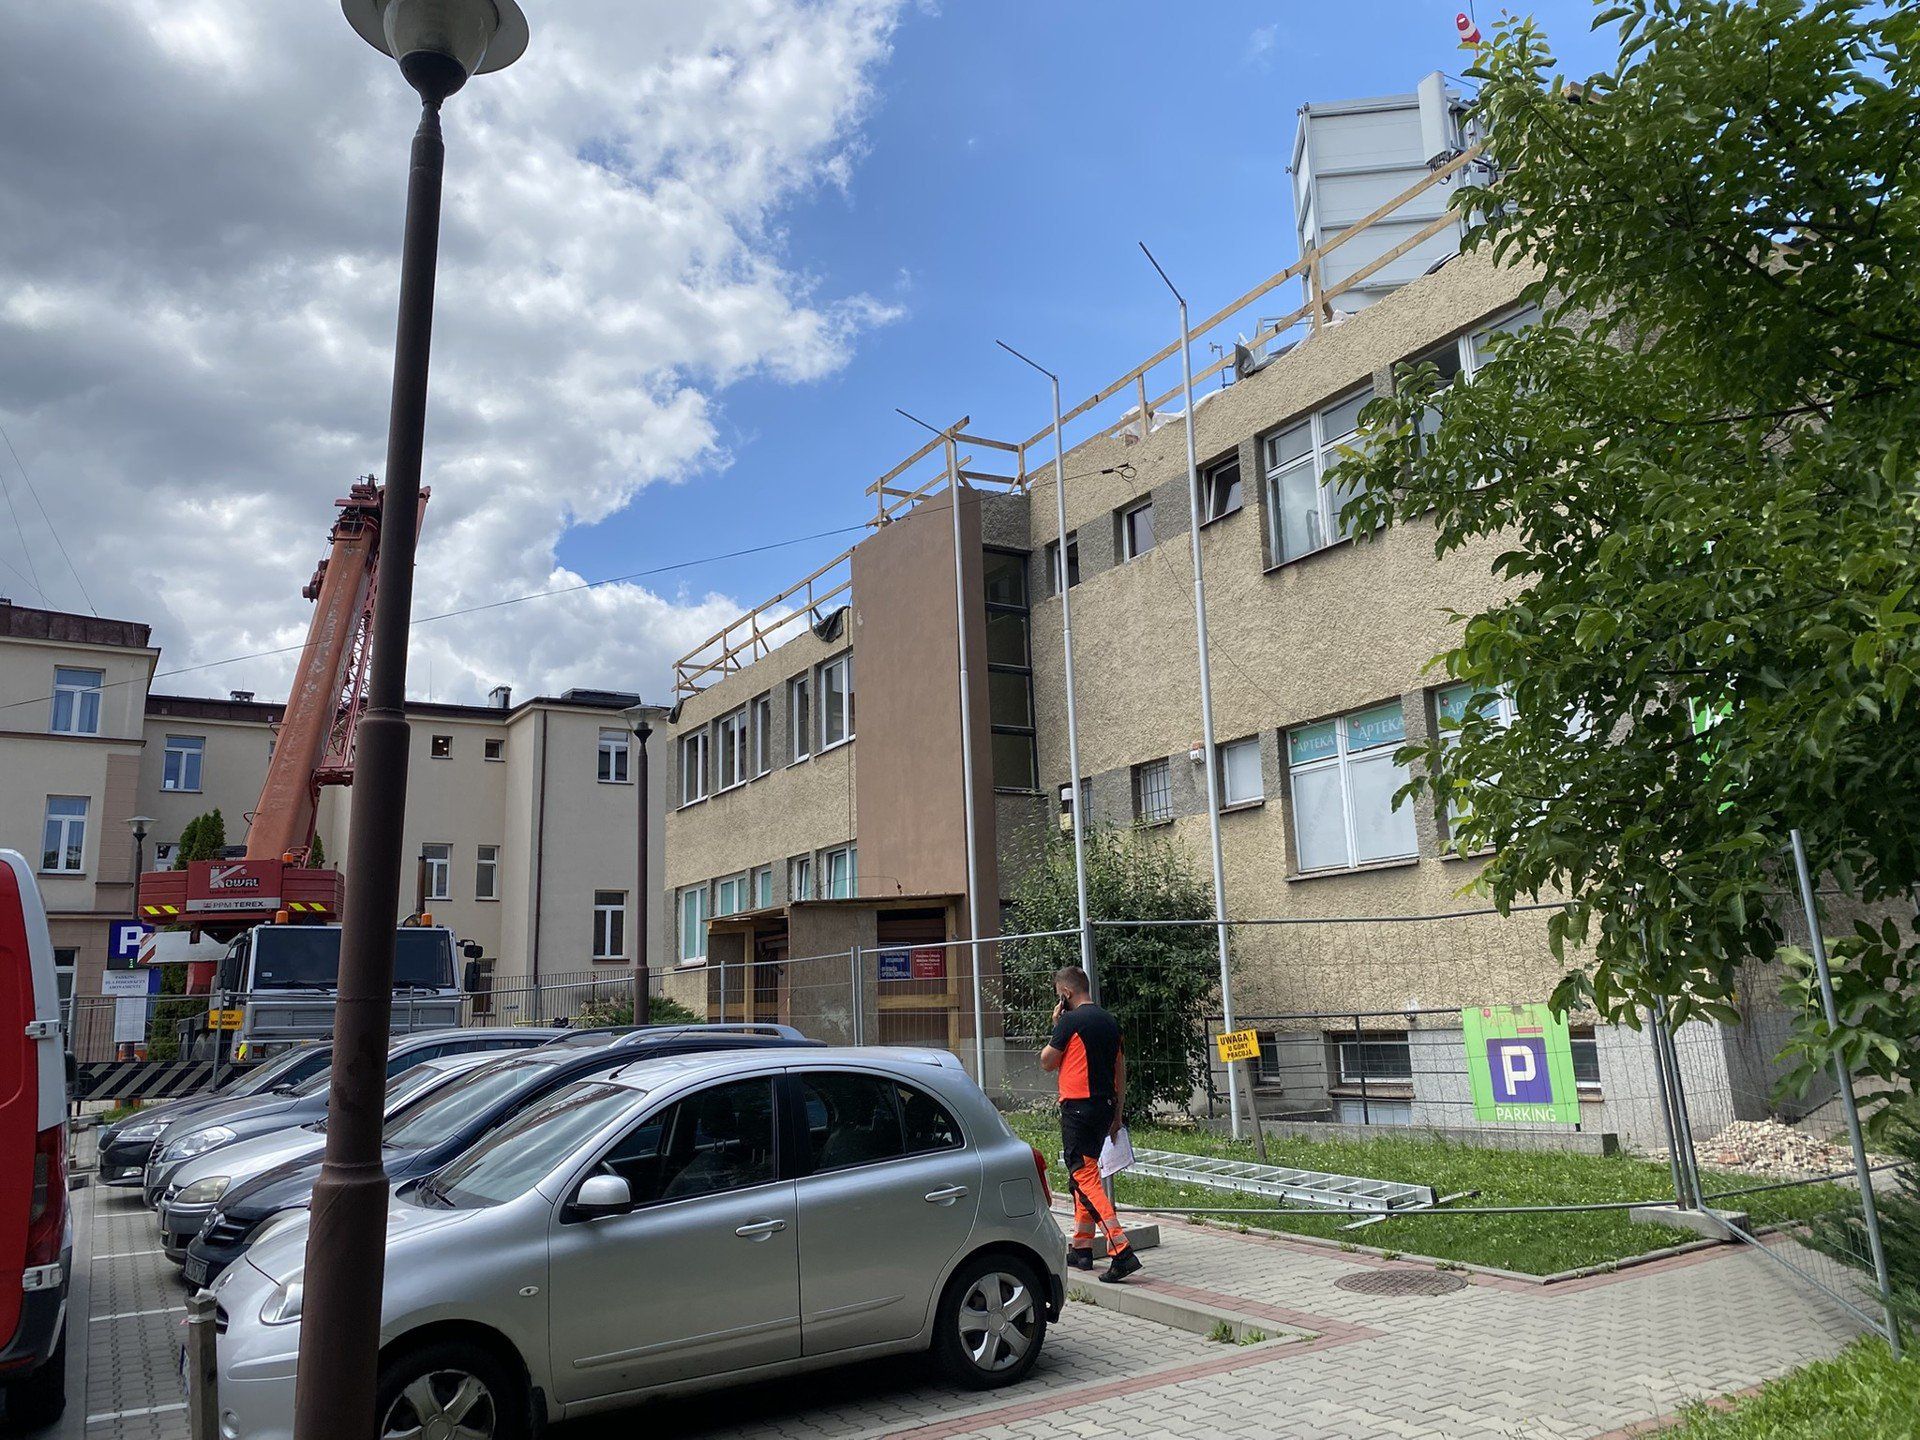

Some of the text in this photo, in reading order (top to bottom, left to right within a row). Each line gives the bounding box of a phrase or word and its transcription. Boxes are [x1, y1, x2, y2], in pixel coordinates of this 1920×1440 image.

[1358, 716, 1404, 739] APTEKA
[1297, 734, 1335, 753] APTEKA
[234, 900, 264, 908] TEREX
[119, 926, 144, 954] P
[1219, 1033, 1249, 1046] UWAGA
[1500, 1045, 1537, 1096] P
[1496, 1106, 1557, 1122] PARKING
